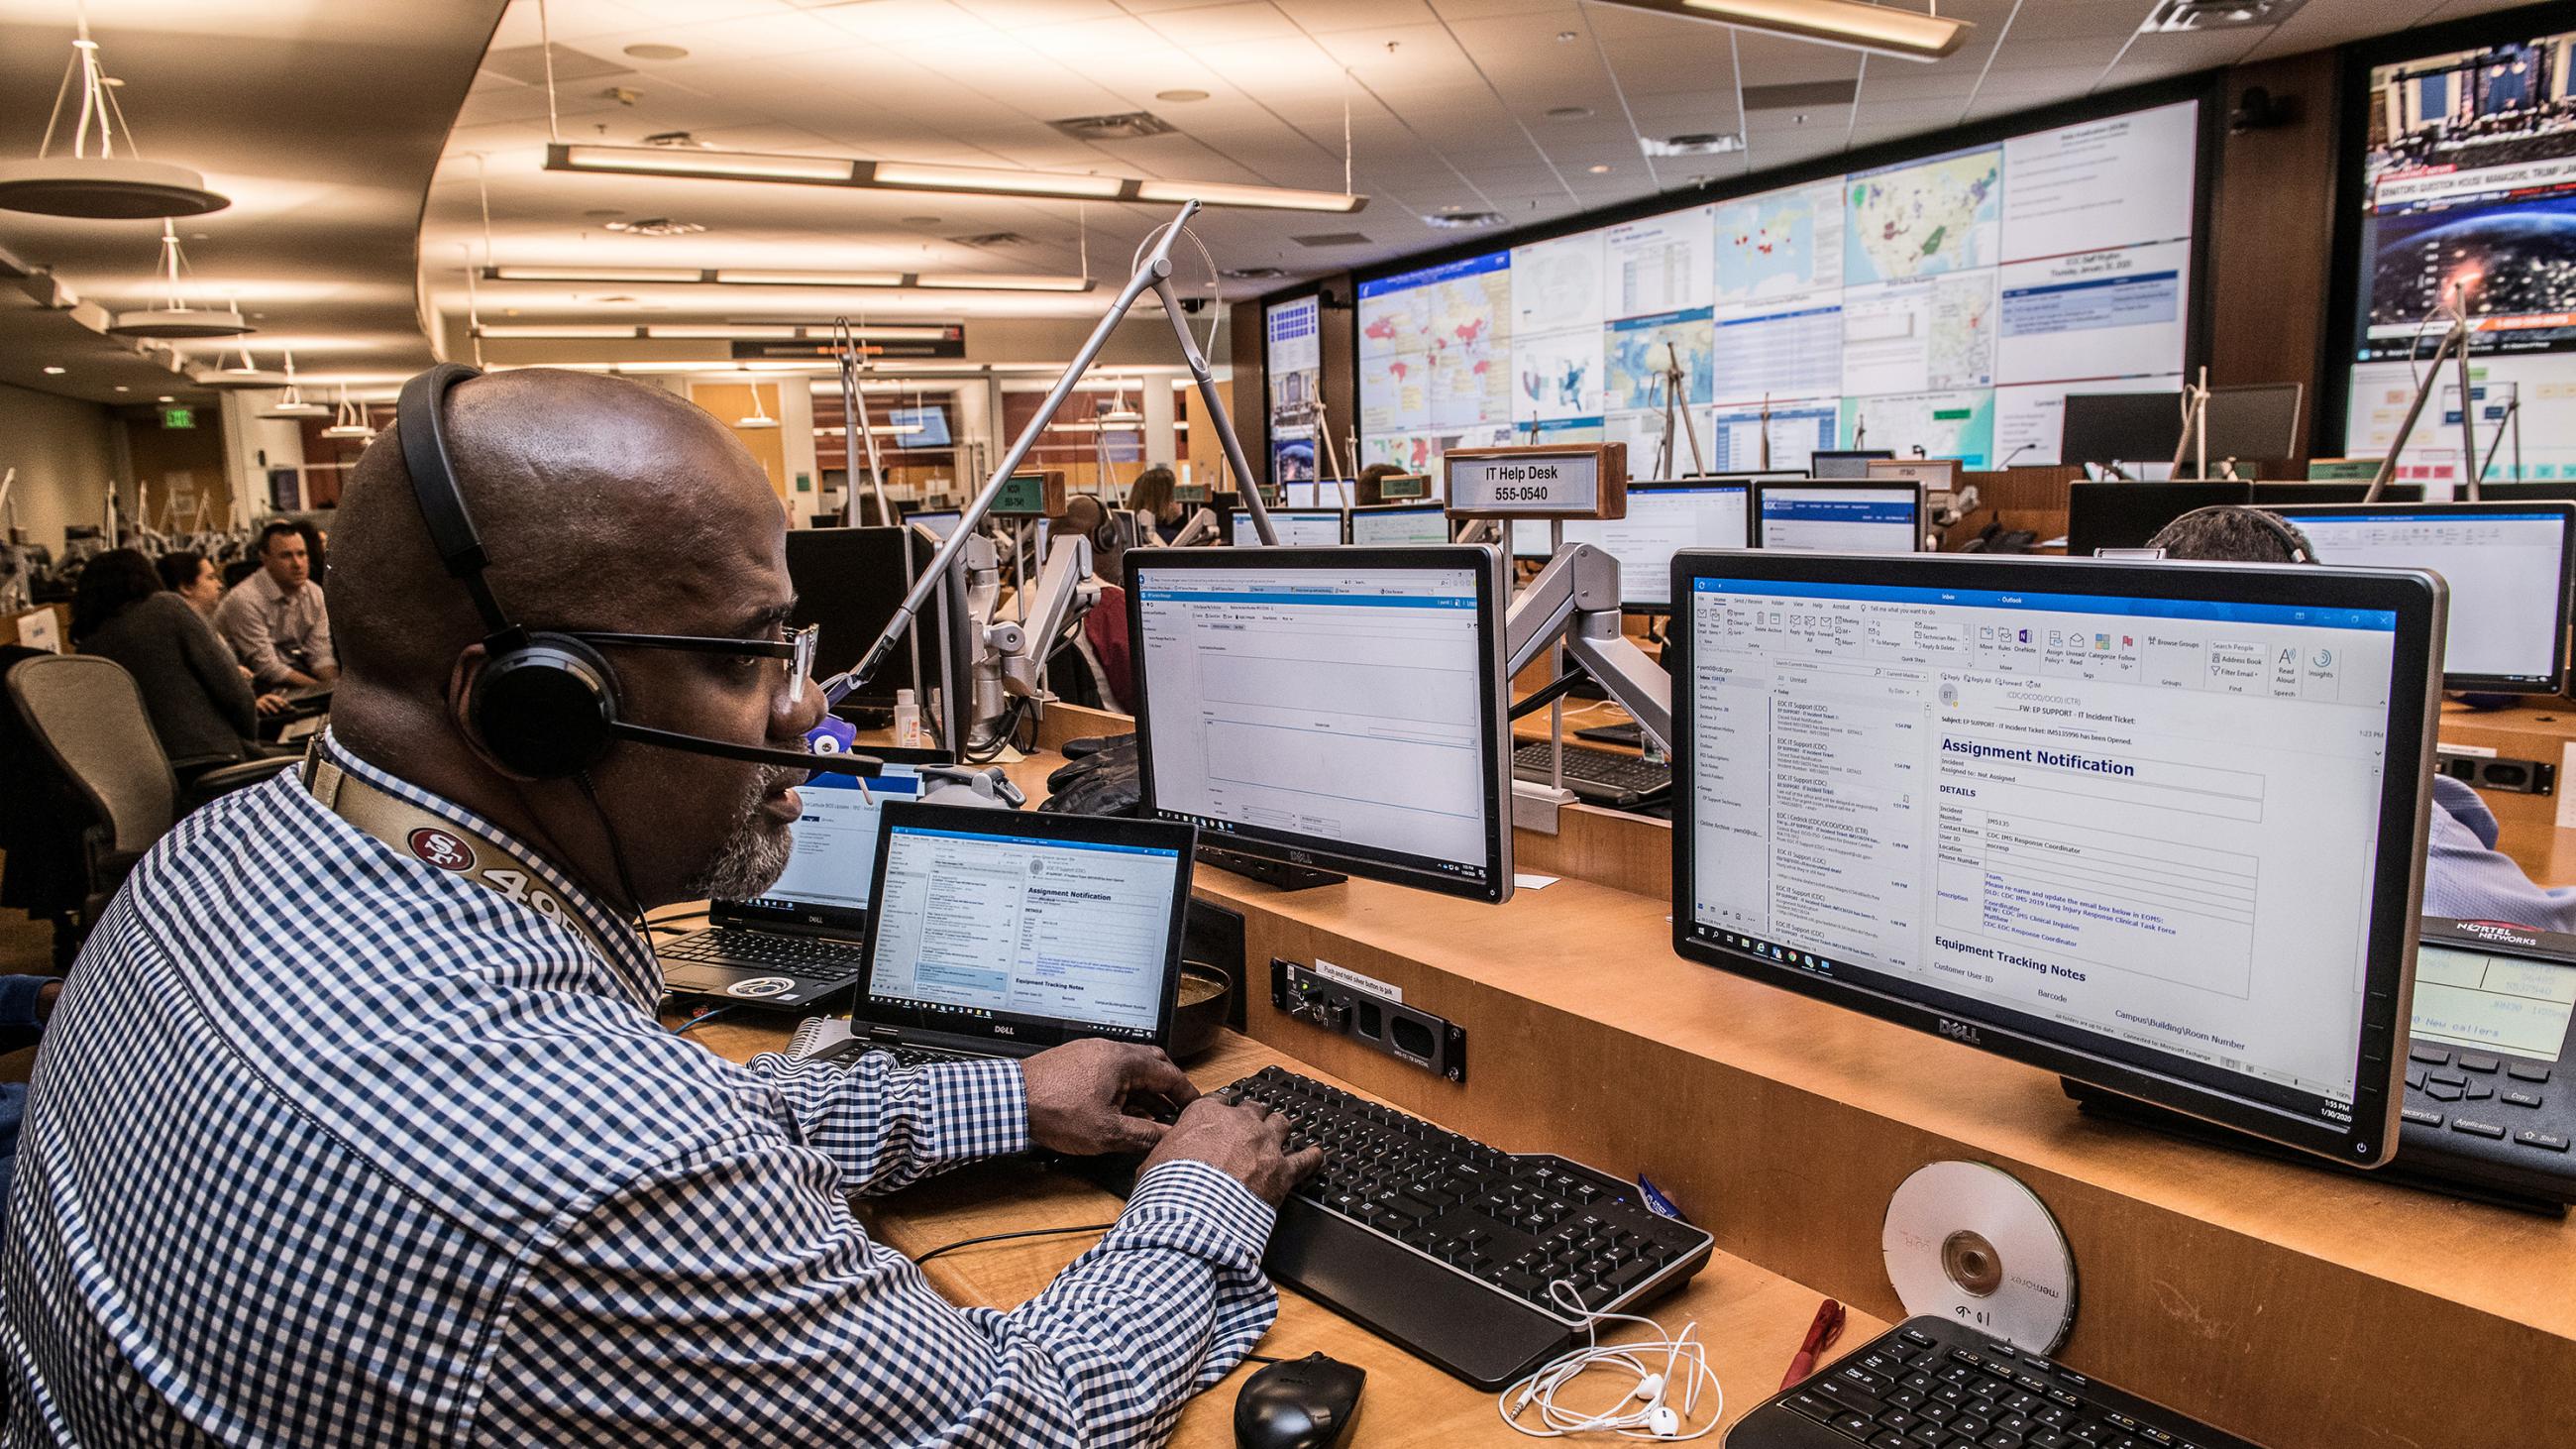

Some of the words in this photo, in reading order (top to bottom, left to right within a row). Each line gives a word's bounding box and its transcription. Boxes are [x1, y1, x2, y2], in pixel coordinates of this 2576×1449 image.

[1486, 467, 1497, 481] IT
[1499, 466, 1526, 483] Help
[1529, 465, 1558, 480] Desk
[1495, 486, 1549, 501] 555-0540
[2221, 655, 2246, 665] Address
[2246, 657, 2263, 666] Book
[2279, 666, 2295, 675] Read
[2308, 670, 2333, 680] Insights
[2276, 676, 2296, 685] Aloud
[1793, 702, 1813, 711] Support
[2042, 707, 2073, 718] SUPPORT
[2086, 712, 2113, 723] Incident
[2114, 714, 2136, 724] Ticket:
[1941, 716, 1963, 724] Subject:
[1971, 719, 1995, 728] SUPPORT
[2004, 724, 2027, 732] Incident
[2028, 725, 2046, 735] Ticket:
[2091, 733, 2106, 742] been
[2106, 735, 2132, 746] Opened.
[1793, 739, 1812, 748] Support
[1941, 757, 1965, 766] Incident
[1942, 737, 2032, 763] Assignment
[2037, 750, 2135, 777] Notification
[1793, 775, 1812, 784] Support
[1941, 766, 1968, 777] Assigned
[1989, 773, 2016, 783] Assigned
[1939, 784, 1977, 798] DETAILS
[1940, 805, 1963, 815] Incident
[1939, 823, 1961, 833] Contact
[1962, 827, 1980, 836] Name
[1939, 842, 1963, 853] Location
[2014, 836, 2043, 848] Response
[2044, 841, 2081, 854] Coordinator
[1939, 852, 1956, 862] Phone
[1957, 855, 1980, 866] Number
[1027, 887, 1069, 897] Assignment
[1070, 890, 1112, 901] Notification
[1937, 890, 1969, 902] Description
[1985, 899, 2020, 912] Coordinator
[2031, 889, 2043, 898] and
[2044, 892, 2067, 904] update
[2067, 896, 2079, 906] the
[2080, 900, 2097, 911] email
[2097, 904, 2110, 913] box
[2111, 907, 2131, 917] below
[808, 915, 824, 925] DELL
[1984, 913, 2008, 923] Matthew
[2028, 897, 2045, 907] 2019
[2045, 901, 2061, 912] Lung
[2062, 905, 2082, 916] Injury
[2083, 909, 2114, 922] Response
[2114, 916, 2139, 928] Clinical
[2140, 921, 2156, 932] Task
[2157, 926, 2177, 936] Force
[2029, 914, 2052, 926] Clinical
[1984, 920, 1996, 929] CDC
[2011, 927, 2040, 939] Response
[2041, 934, 2078, 947] Coordinator
[2456, 922, 2512, 937] NORTEL
[2478, 932, 2537, 947] NETWORKS
[1935, 935, 1994, 959] Equipment
[1996, 950, 2047, 974] Tracking
[2050, 963, 2087, 982] Notes
[1934, 961, 1966, 976] Customer
[1016, 976, 1044, 987] Equipment
[1044, 979, 1068, 990] Tracking
[1324, 965, 1335, 974] Push
[1342, 971, 1353, 981] hold
[1353, 976, 1365, 985] silver
[1365, 979, 1379, 991] button
[2038, 988, 2068, 1004] Barcode
[994, 1025, 1015, 1036] DELL
[1939, 1018, 1981, 1046] DELL
[2114, 1009, 2209, 1041] Campus\Building\Room
[2210, 1035, 2246, 1052] Number
[2425, 1017, 2446, 1030] New
[2452, 1023, 2500, 1039] callers
[2122, 1031, 2151, 1046] Connected
[2159, 1042, 2185, 1055] Microsoft
[2185, 1048, 2211, 1061] Exchange
[2511, 1091, 2529, 1102] Copy
[2324, 1099, 2337, 1109] 1:55
[2338, 1102, 2350, 1112] PM
[2321, 1108, 2352, 1122] 1/30/2020
[2401, 1107, 2440, 1121] rectory/Log
[2455, 1117, 2501, 1133] Applications
[2538, 1134, 2557, 1144] Shift
[2009, 1275, 2059, 1299] memorex
[1872, 1355, 1882, 1364] Tab
